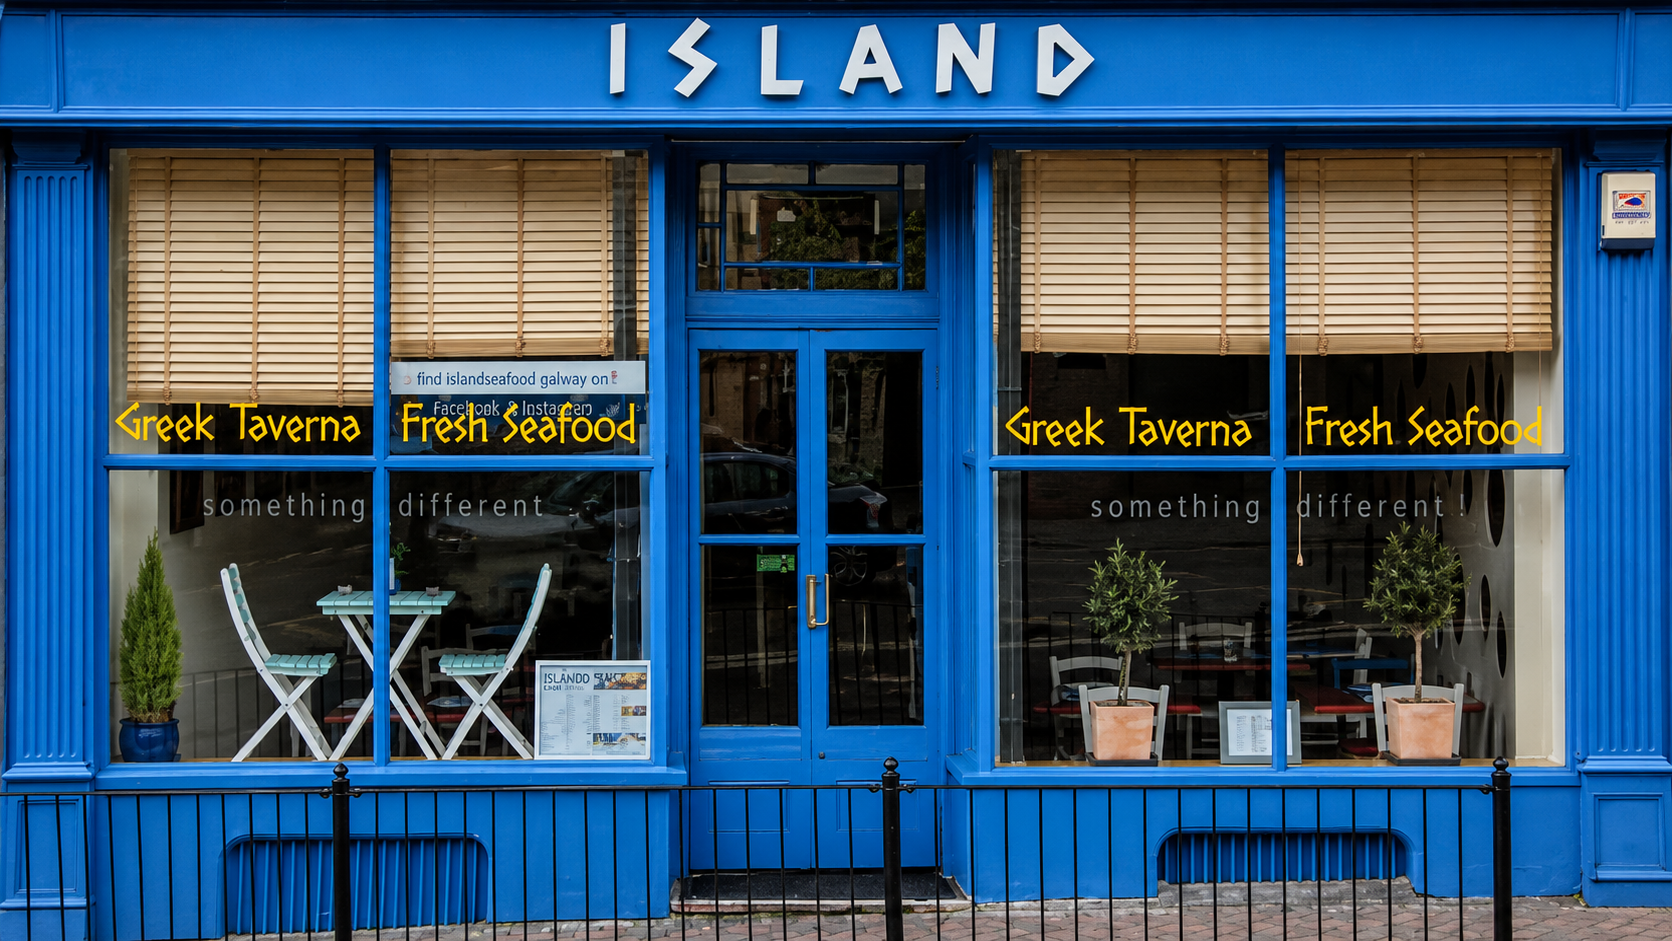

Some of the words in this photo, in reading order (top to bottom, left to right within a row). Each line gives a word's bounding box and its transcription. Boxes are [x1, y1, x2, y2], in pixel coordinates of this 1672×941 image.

[609, 17, 1096, 98] ISLAND
[416, 371, 442, 386] find
[446, 371, 536, 386] islandseafood
[540, 371, 588, 389] galway
[591, 375, 609, 386] on
[114, 402, 215, 443] Greek
[229, 402, 362, 444] Taverna
[401, 402, 489, 444] Fresh
[502, 401, 637, 445] Seafood
[1005, 405, 1105, 448] Greek
[1118, 406, 1253, 448] Taverna
[1305, 405, 1394, 448] Fresh
[1407, 405, 1543, 448] Seafood
[203, 492, 366, 523] something
[398, 492, 543, 518] different
[1091, 493, 1260, 523] something
[1296, 493, 1445, 518] different
